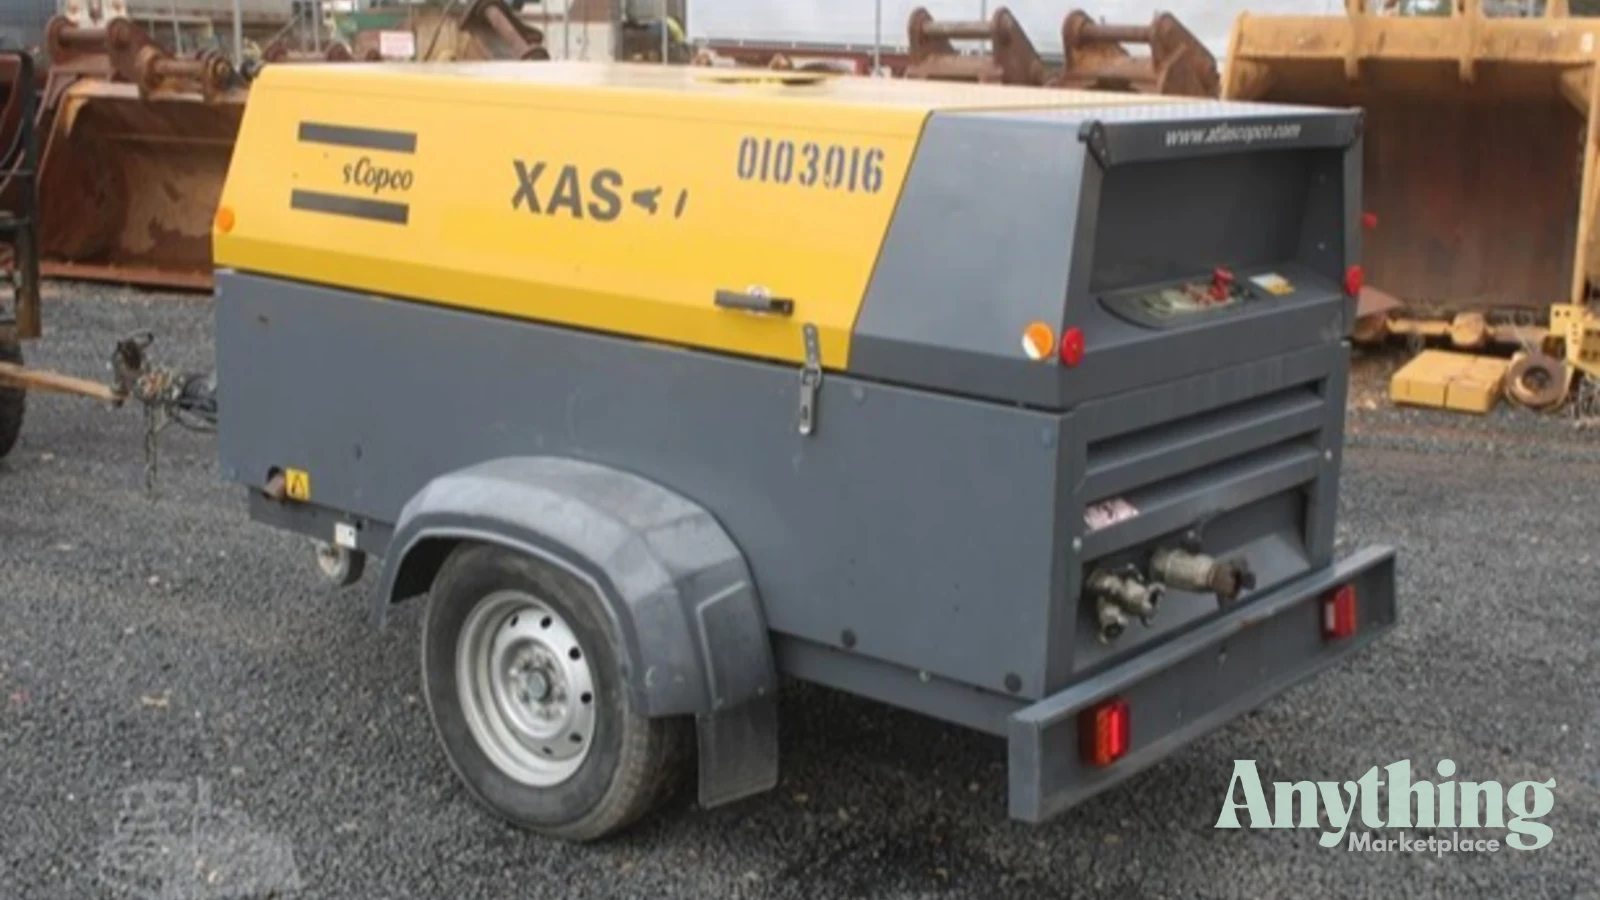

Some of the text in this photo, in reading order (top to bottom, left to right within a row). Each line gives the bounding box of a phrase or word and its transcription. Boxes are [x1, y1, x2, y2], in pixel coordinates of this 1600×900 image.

[1166, 122, 1302, 146] www.atlascopco.com
[511, 158, 624, 222] XAS
[737, 137, 884, 194] 0103016
